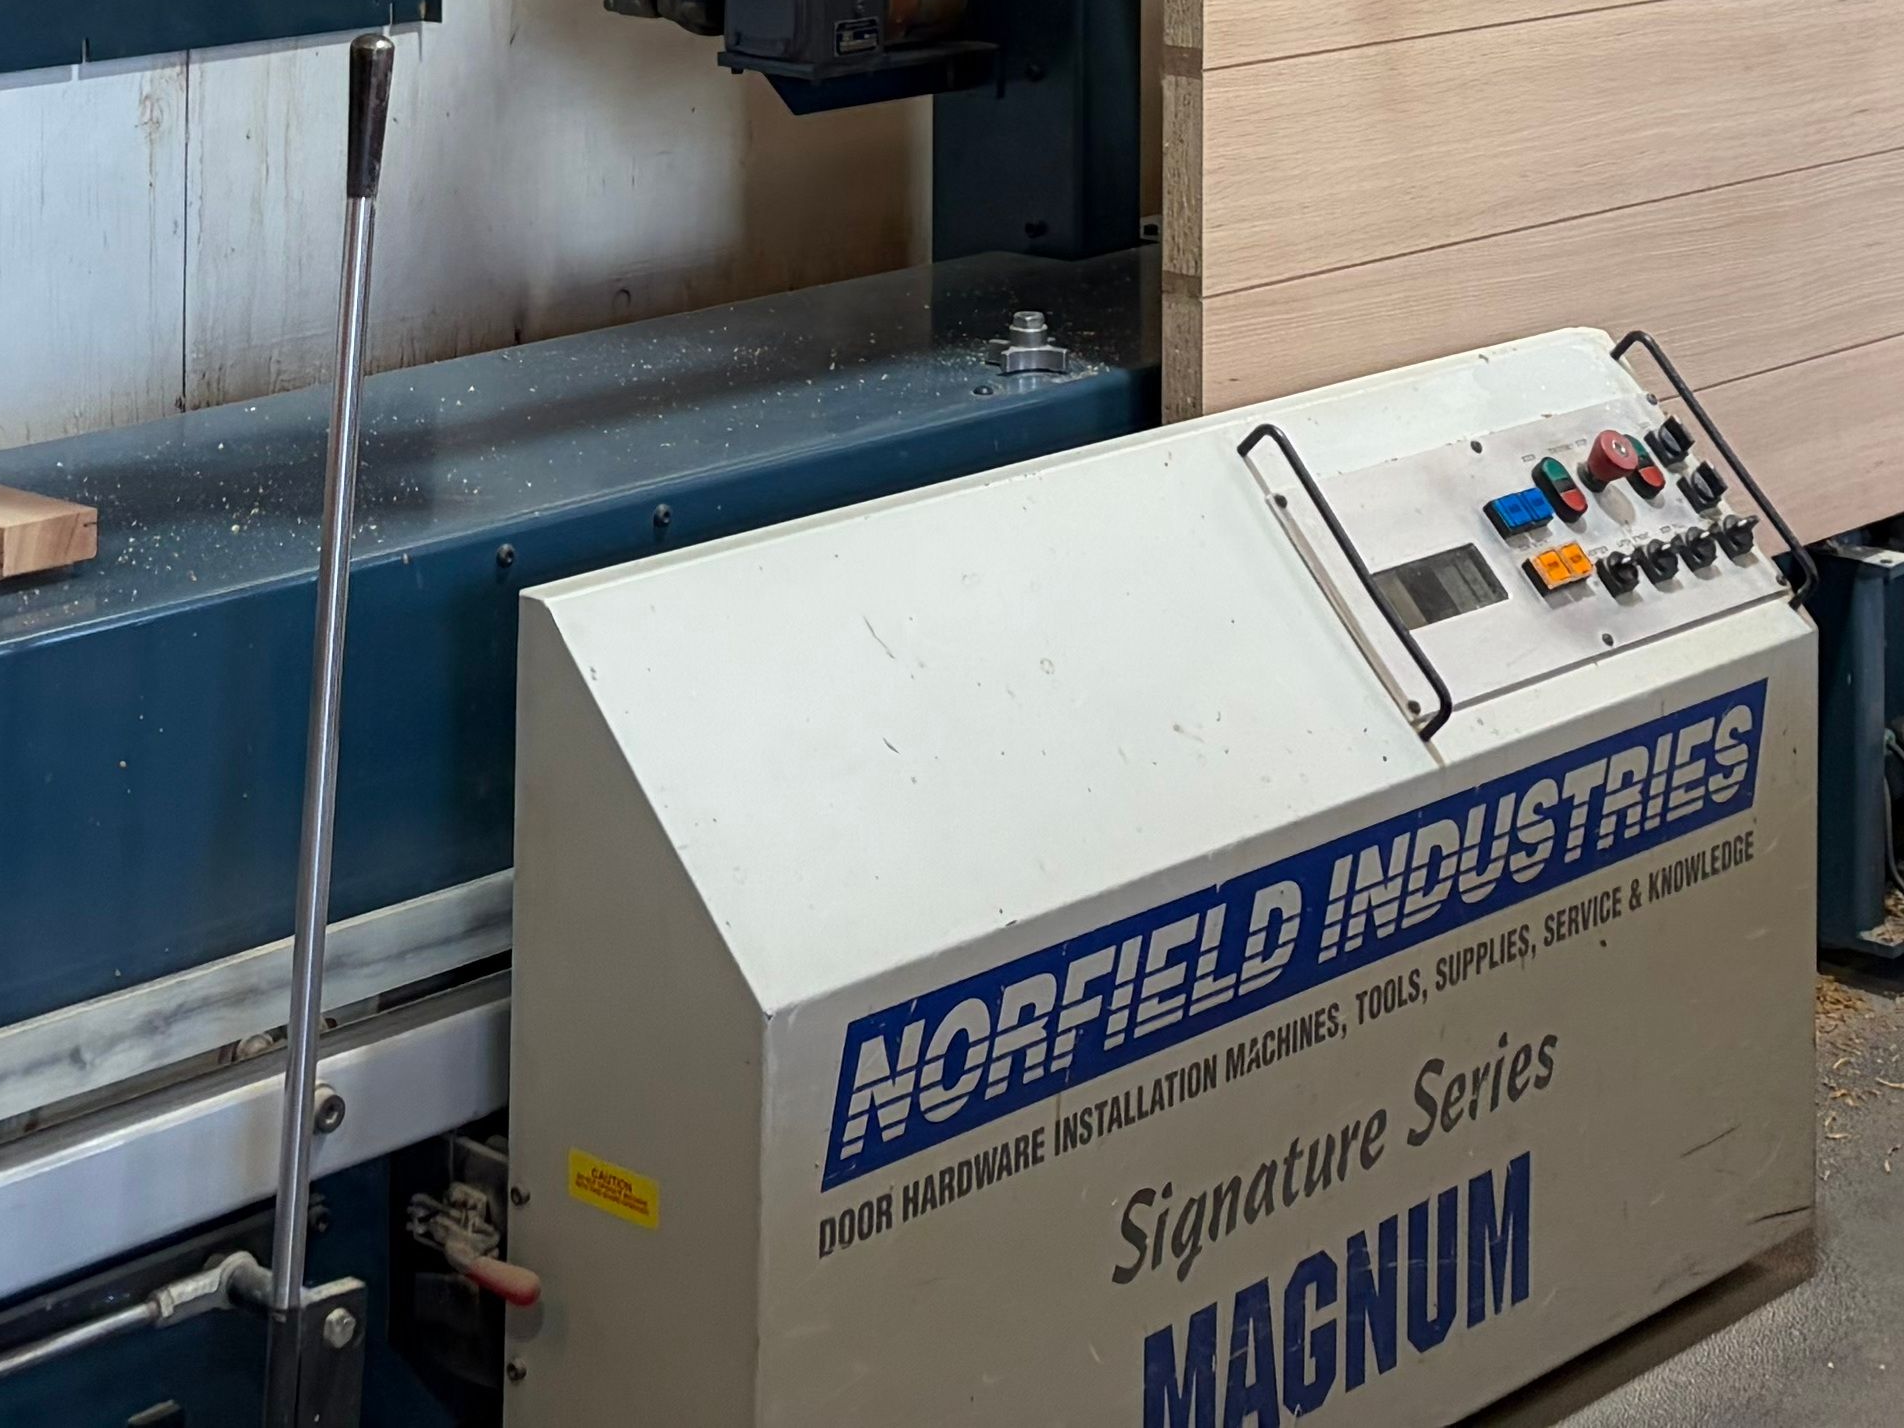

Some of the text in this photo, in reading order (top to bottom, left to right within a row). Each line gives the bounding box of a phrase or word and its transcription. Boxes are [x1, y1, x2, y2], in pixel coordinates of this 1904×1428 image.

[817, 829, 1755, 1261] DOOR HARDWARE INSTALLATION MACHINES, TOOLS, SUPPLIES, SERVICE & KNOWLEDGE
[839, 703, 1754, 1162] NORFIELD INDUSTRIES
[1111, 1030, 1559, 1286] Signature Series
[1142, 1149, 1531, 1428] MAGNUM
